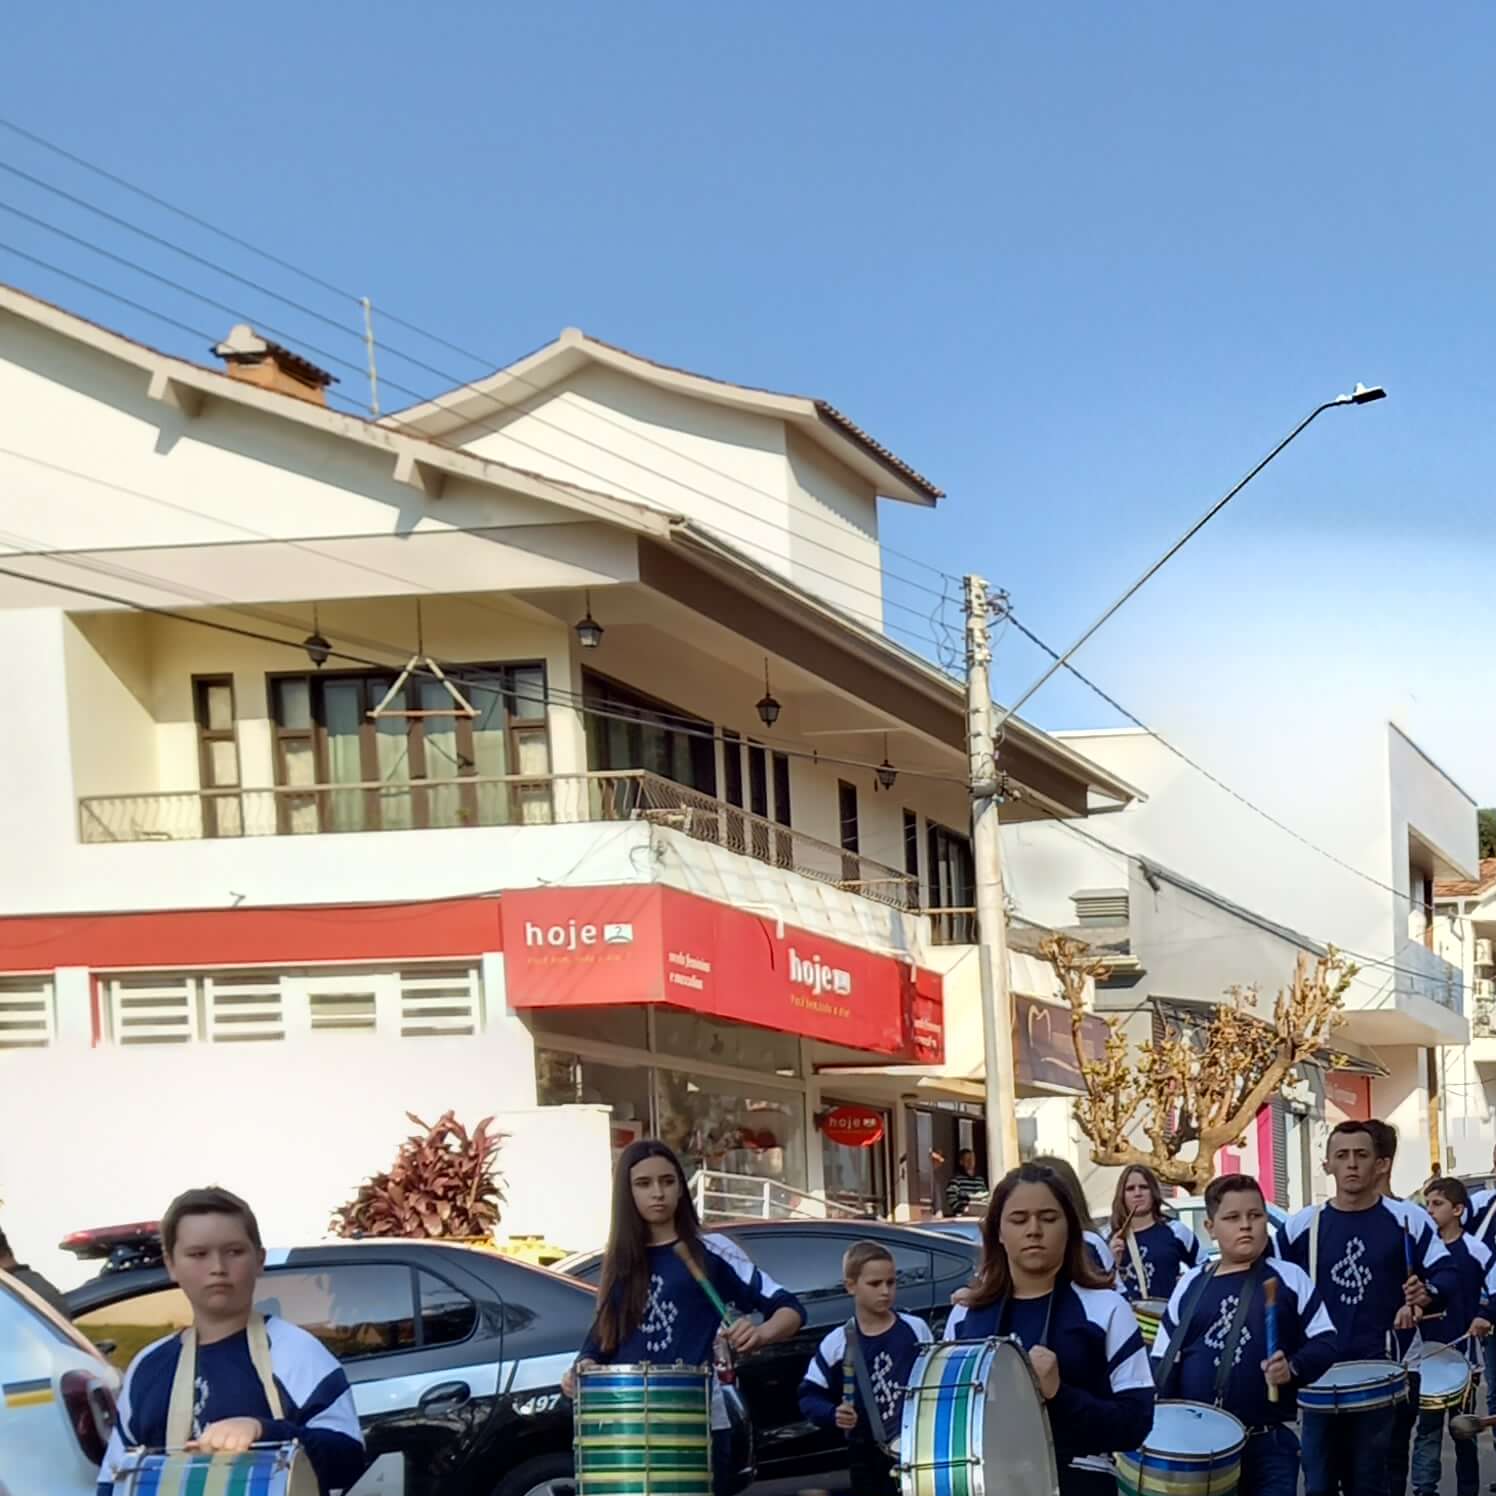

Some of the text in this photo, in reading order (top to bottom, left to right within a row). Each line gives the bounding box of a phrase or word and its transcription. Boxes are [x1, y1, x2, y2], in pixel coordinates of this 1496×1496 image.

[525, 919, 597, 951] hoje
[788, 947, 833, 996] hoje
[829, 1116, 860, 1129] hoje
